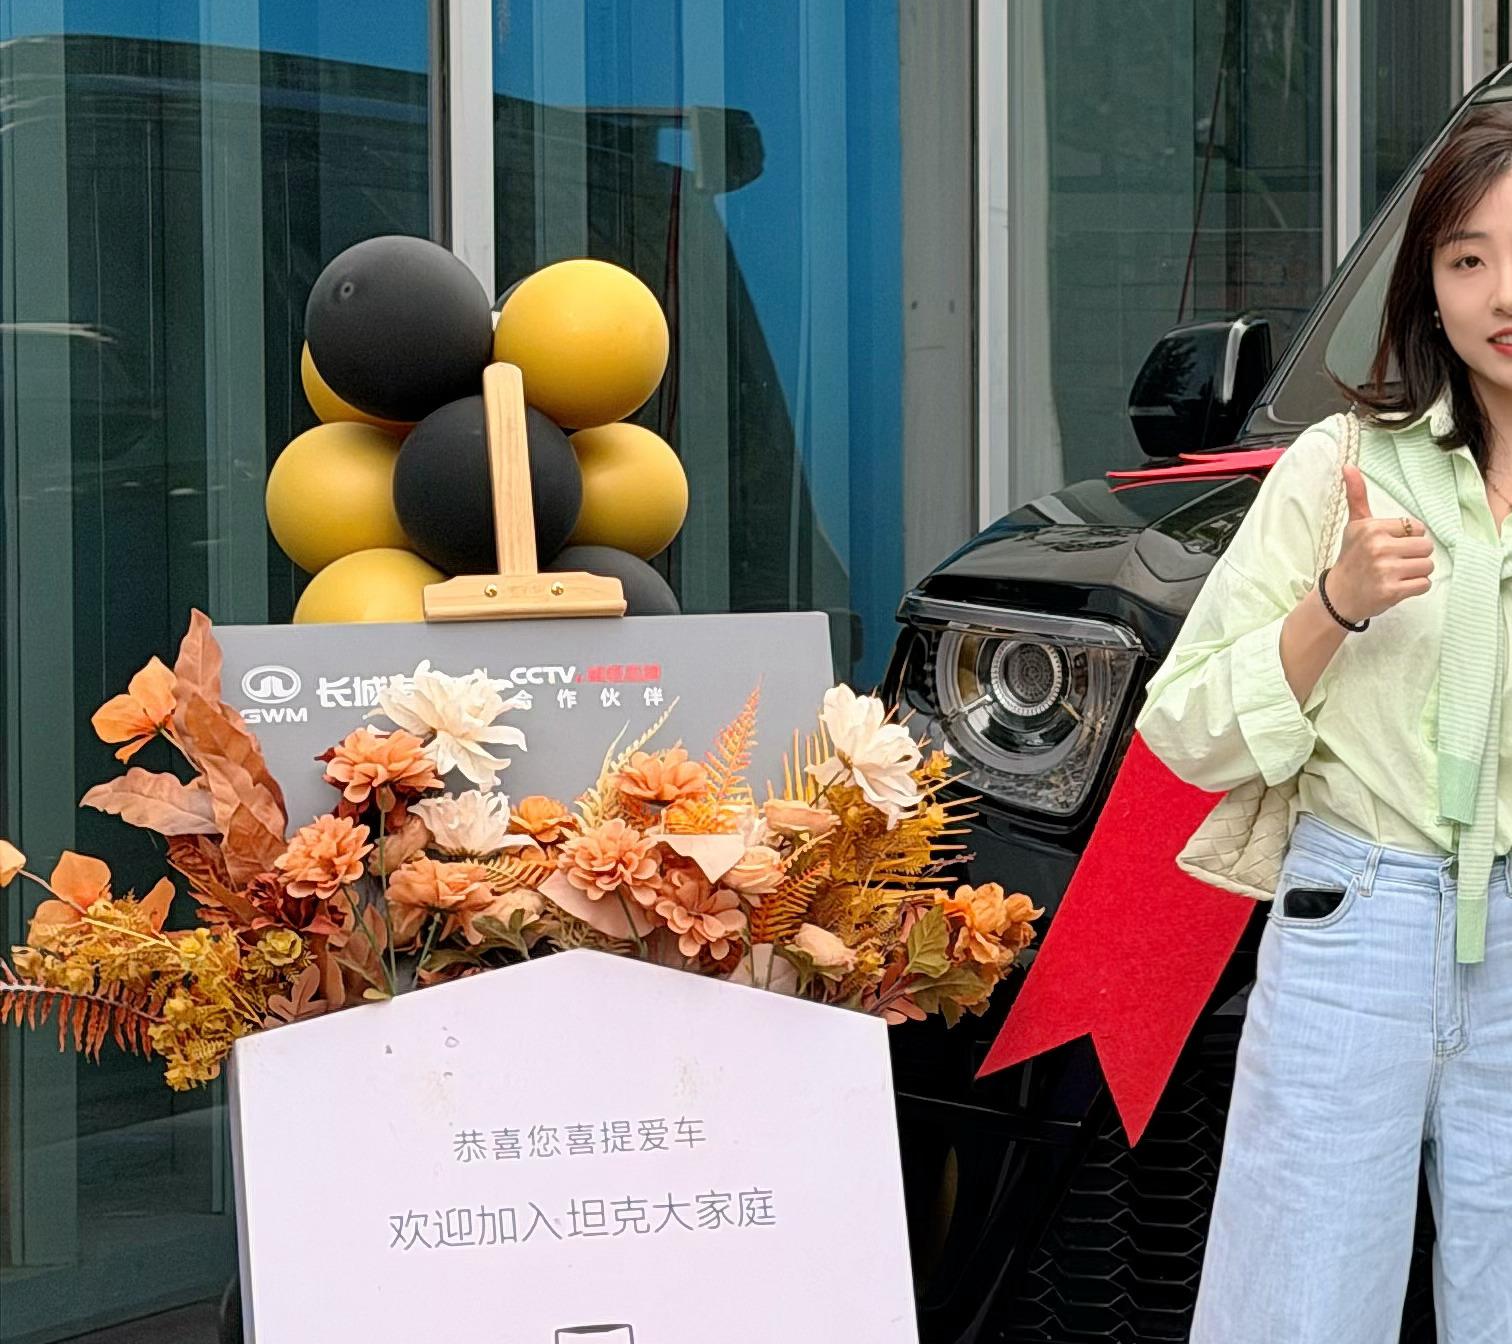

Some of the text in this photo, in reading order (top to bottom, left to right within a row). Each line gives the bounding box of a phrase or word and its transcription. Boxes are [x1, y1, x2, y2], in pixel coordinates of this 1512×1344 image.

[239, 707, 308, 724] GWM
[452, 1116, 707, 1163] 恭喜您喜提爱车
[389, 1186, 777, 1251] 欢迎加入坦克大家庭
